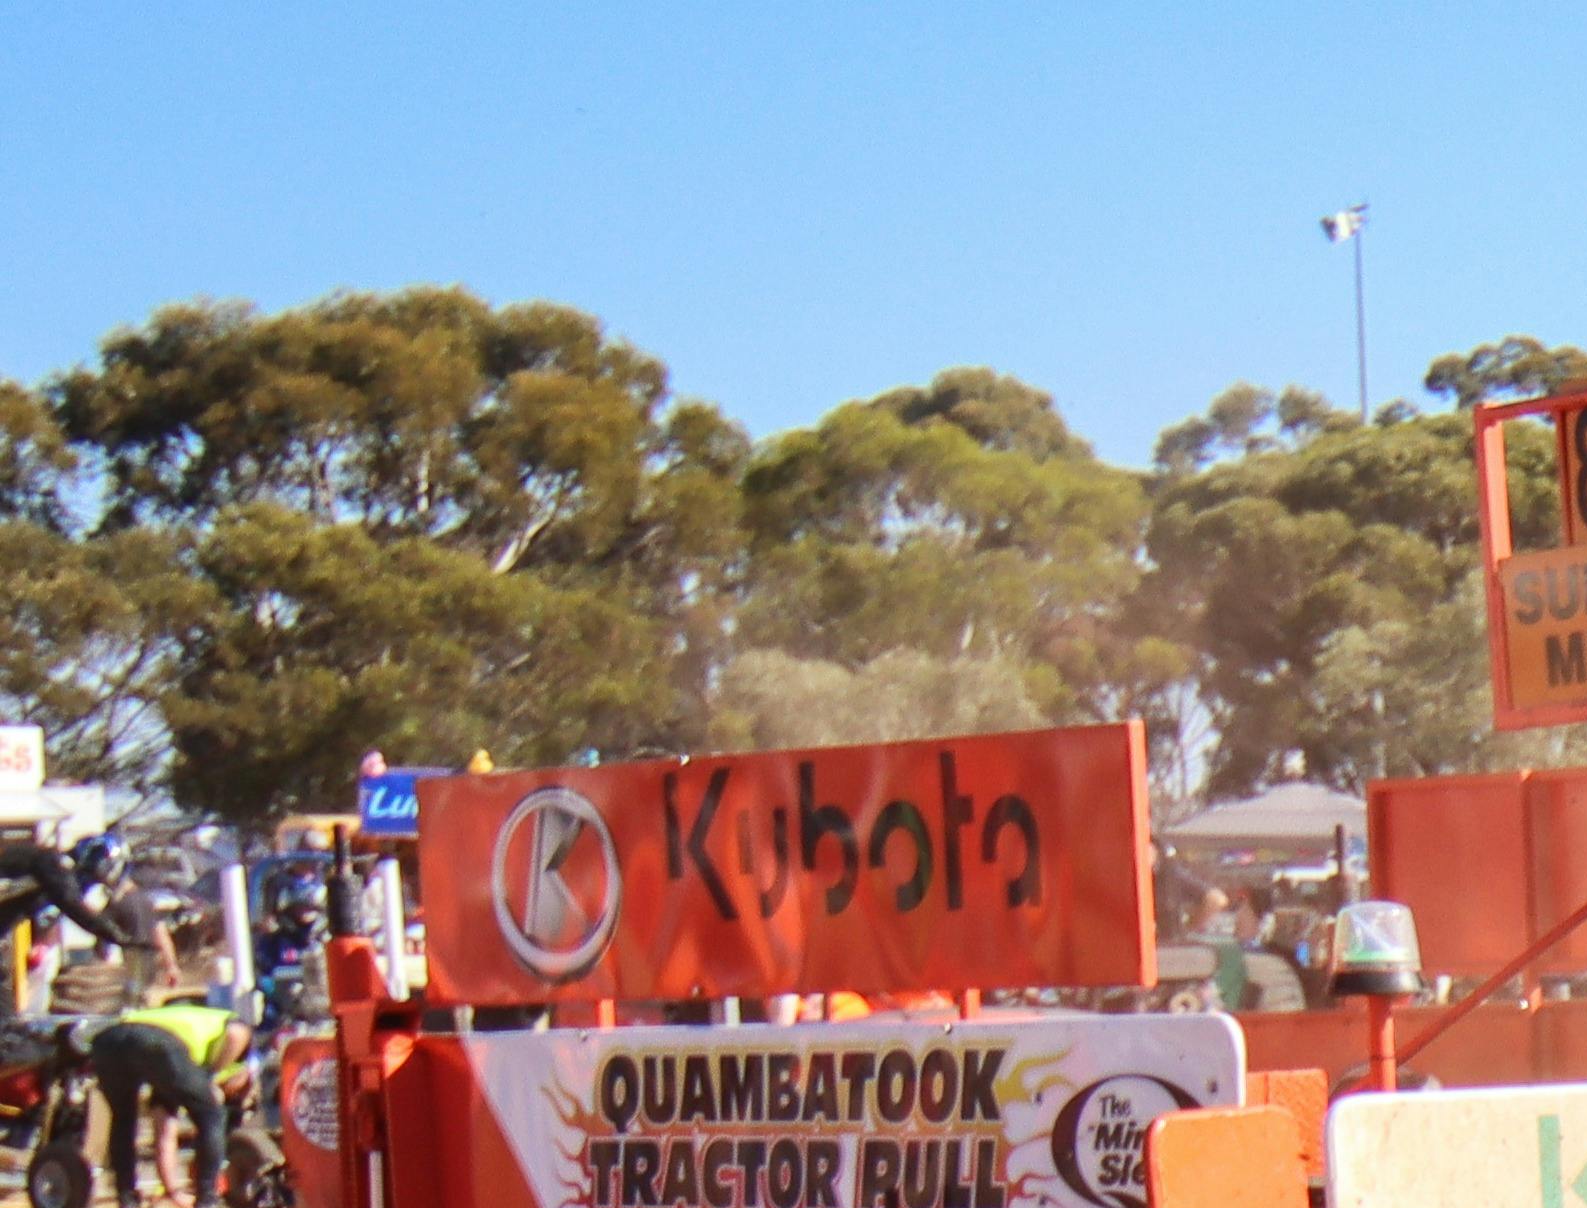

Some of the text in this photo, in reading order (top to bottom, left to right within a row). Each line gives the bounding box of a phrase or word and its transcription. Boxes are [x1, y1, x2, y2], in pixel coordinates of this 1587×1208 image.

[664, 752, 1042, 920] Kubota
[601, 1049, 1006, 1132] QUAMBATOOK
[1101, 1095, 1130, 1117] The
